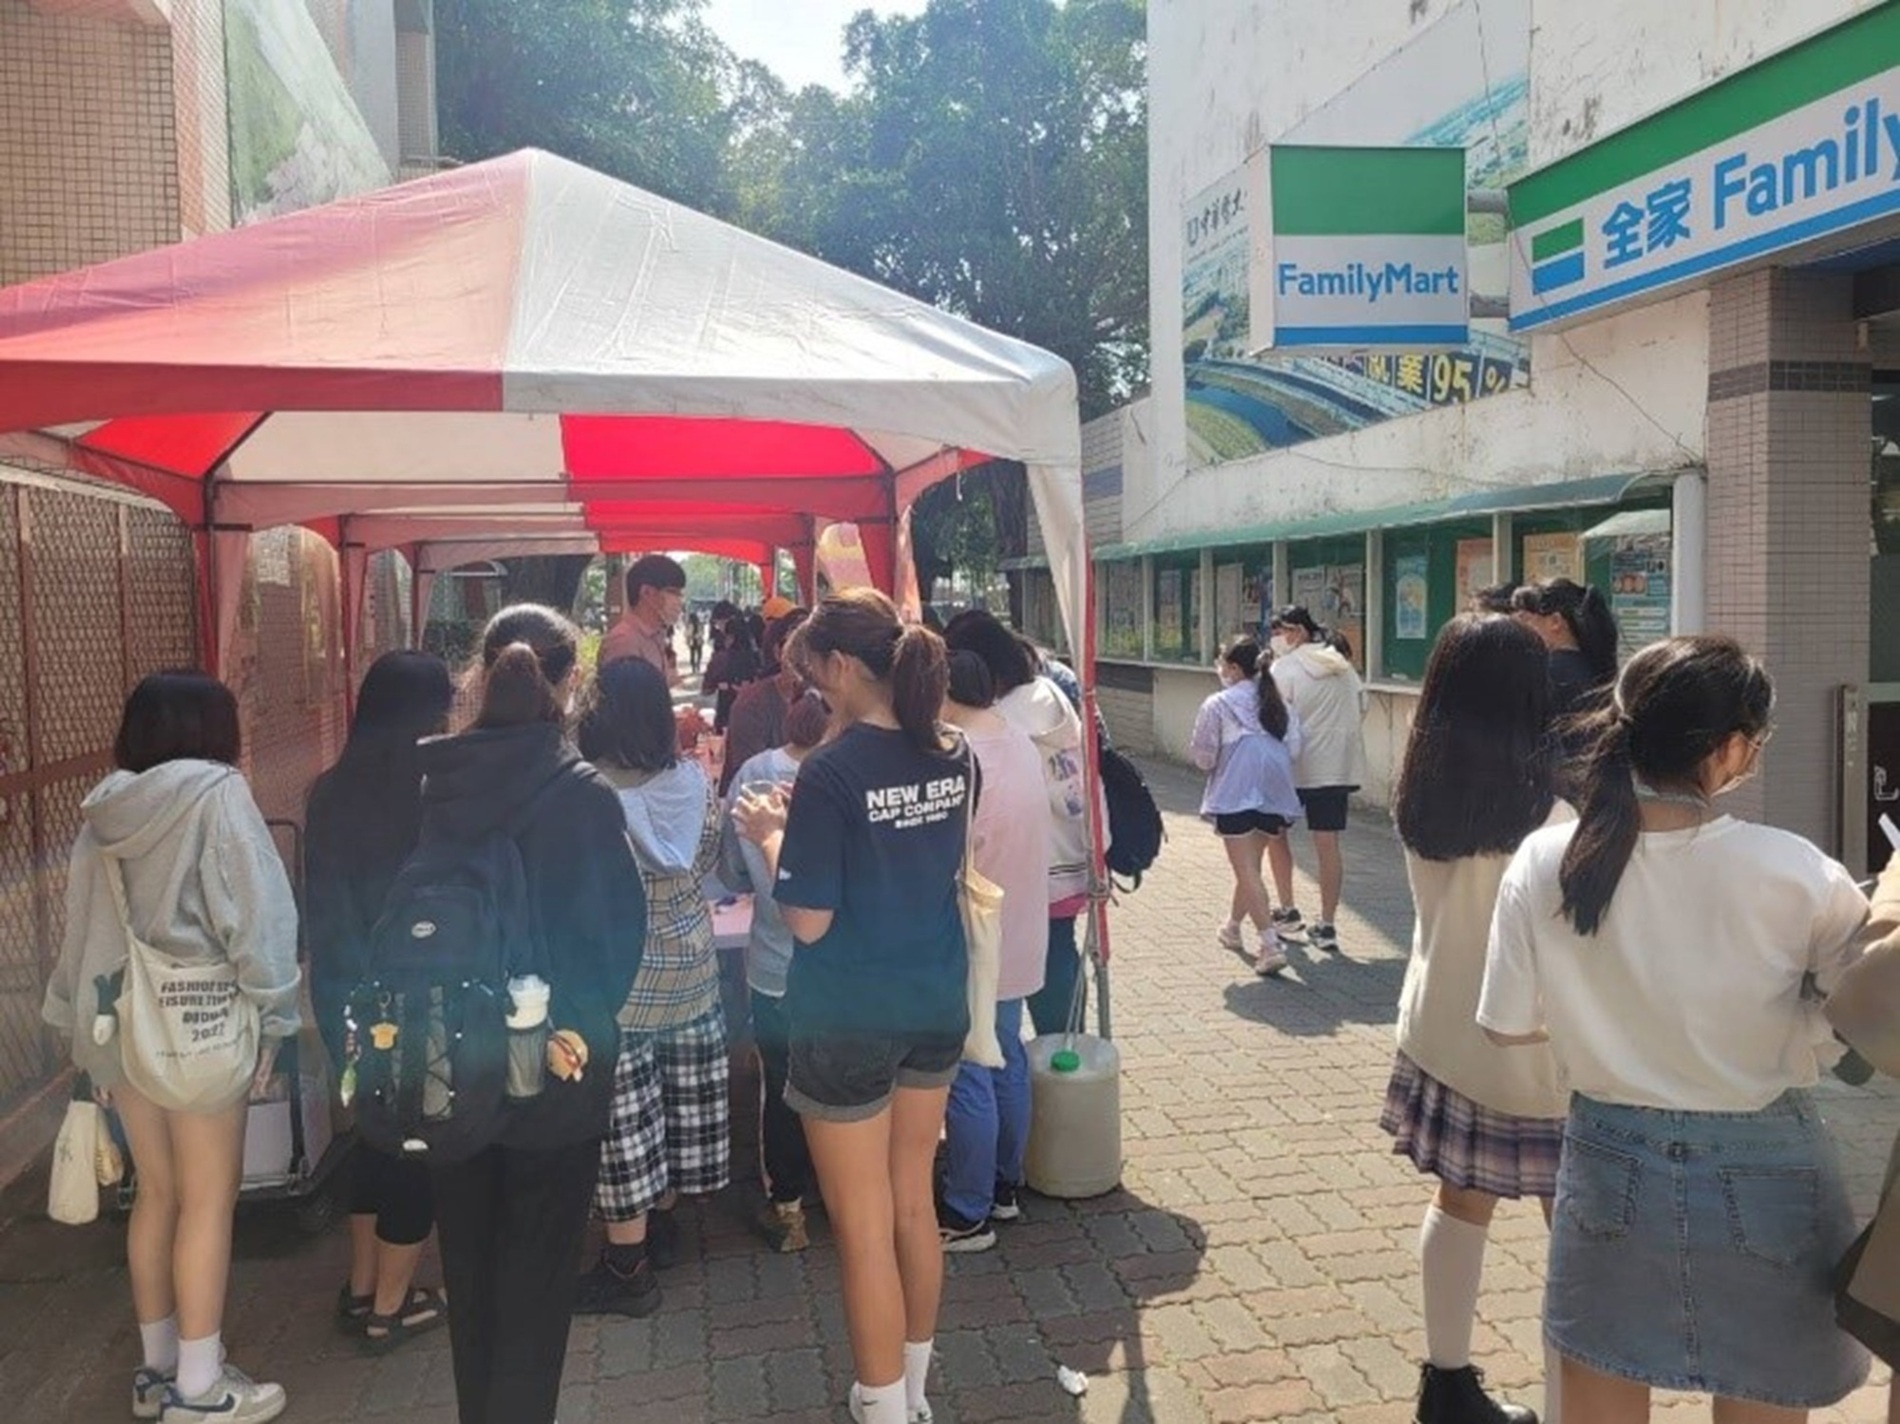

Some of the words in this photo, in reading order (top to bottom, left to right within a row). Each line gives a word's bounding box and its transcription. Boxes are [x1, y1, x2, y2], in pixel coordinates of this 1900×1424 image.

[1602, 178, 1691, 269] 全家
[1278, 262, 1460, 303] FamilyMart
[866, 784, 919, 809] NEW
[926, 774, 966, 800] ERA
[868, 807, 902, 822] CAP
